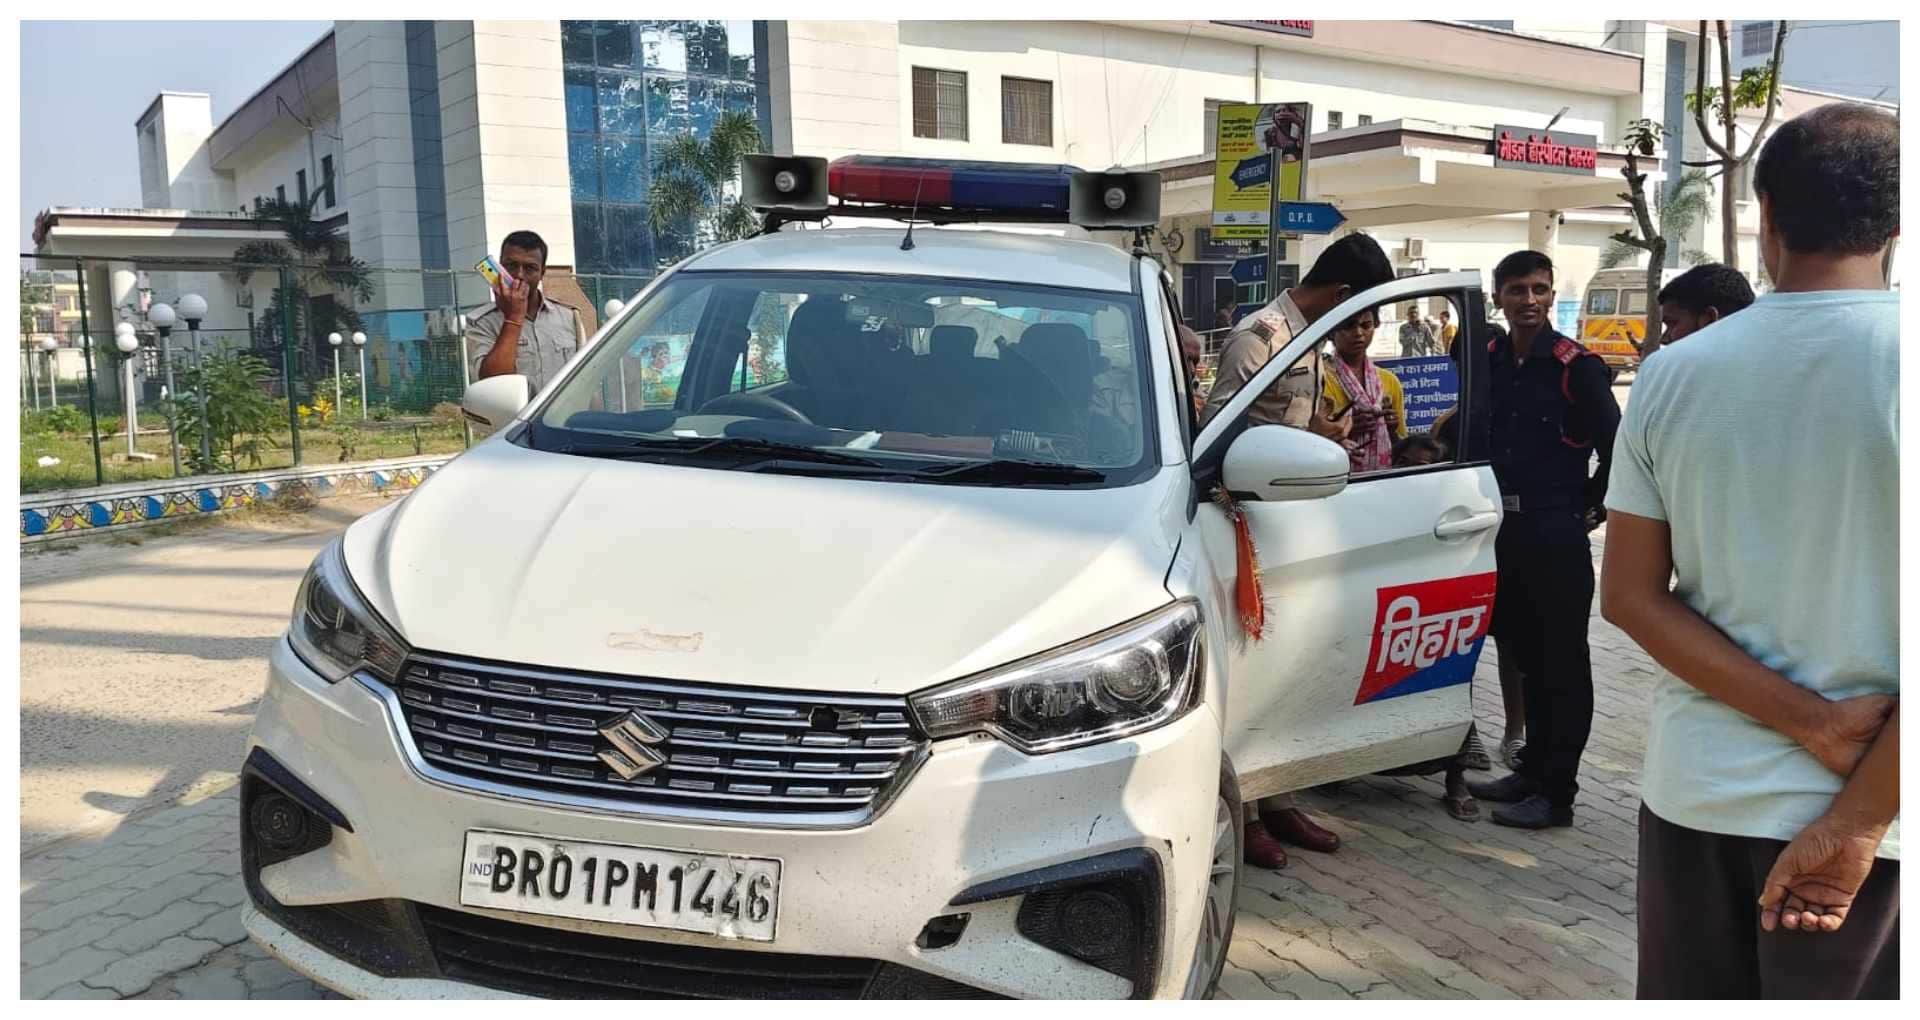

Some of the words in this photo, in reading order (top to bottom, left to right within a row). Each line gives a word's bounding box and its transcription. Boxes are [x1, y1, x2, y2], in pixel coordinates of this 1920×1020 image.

[1420, 377, 1440, 387] दिन
[1422, 362, 1449, 372] समय
[1376, 595, 1488, 673] बिहार
[469, 862, 492, 876] IND
[490, 846, 774, 923] BR01PM1446
